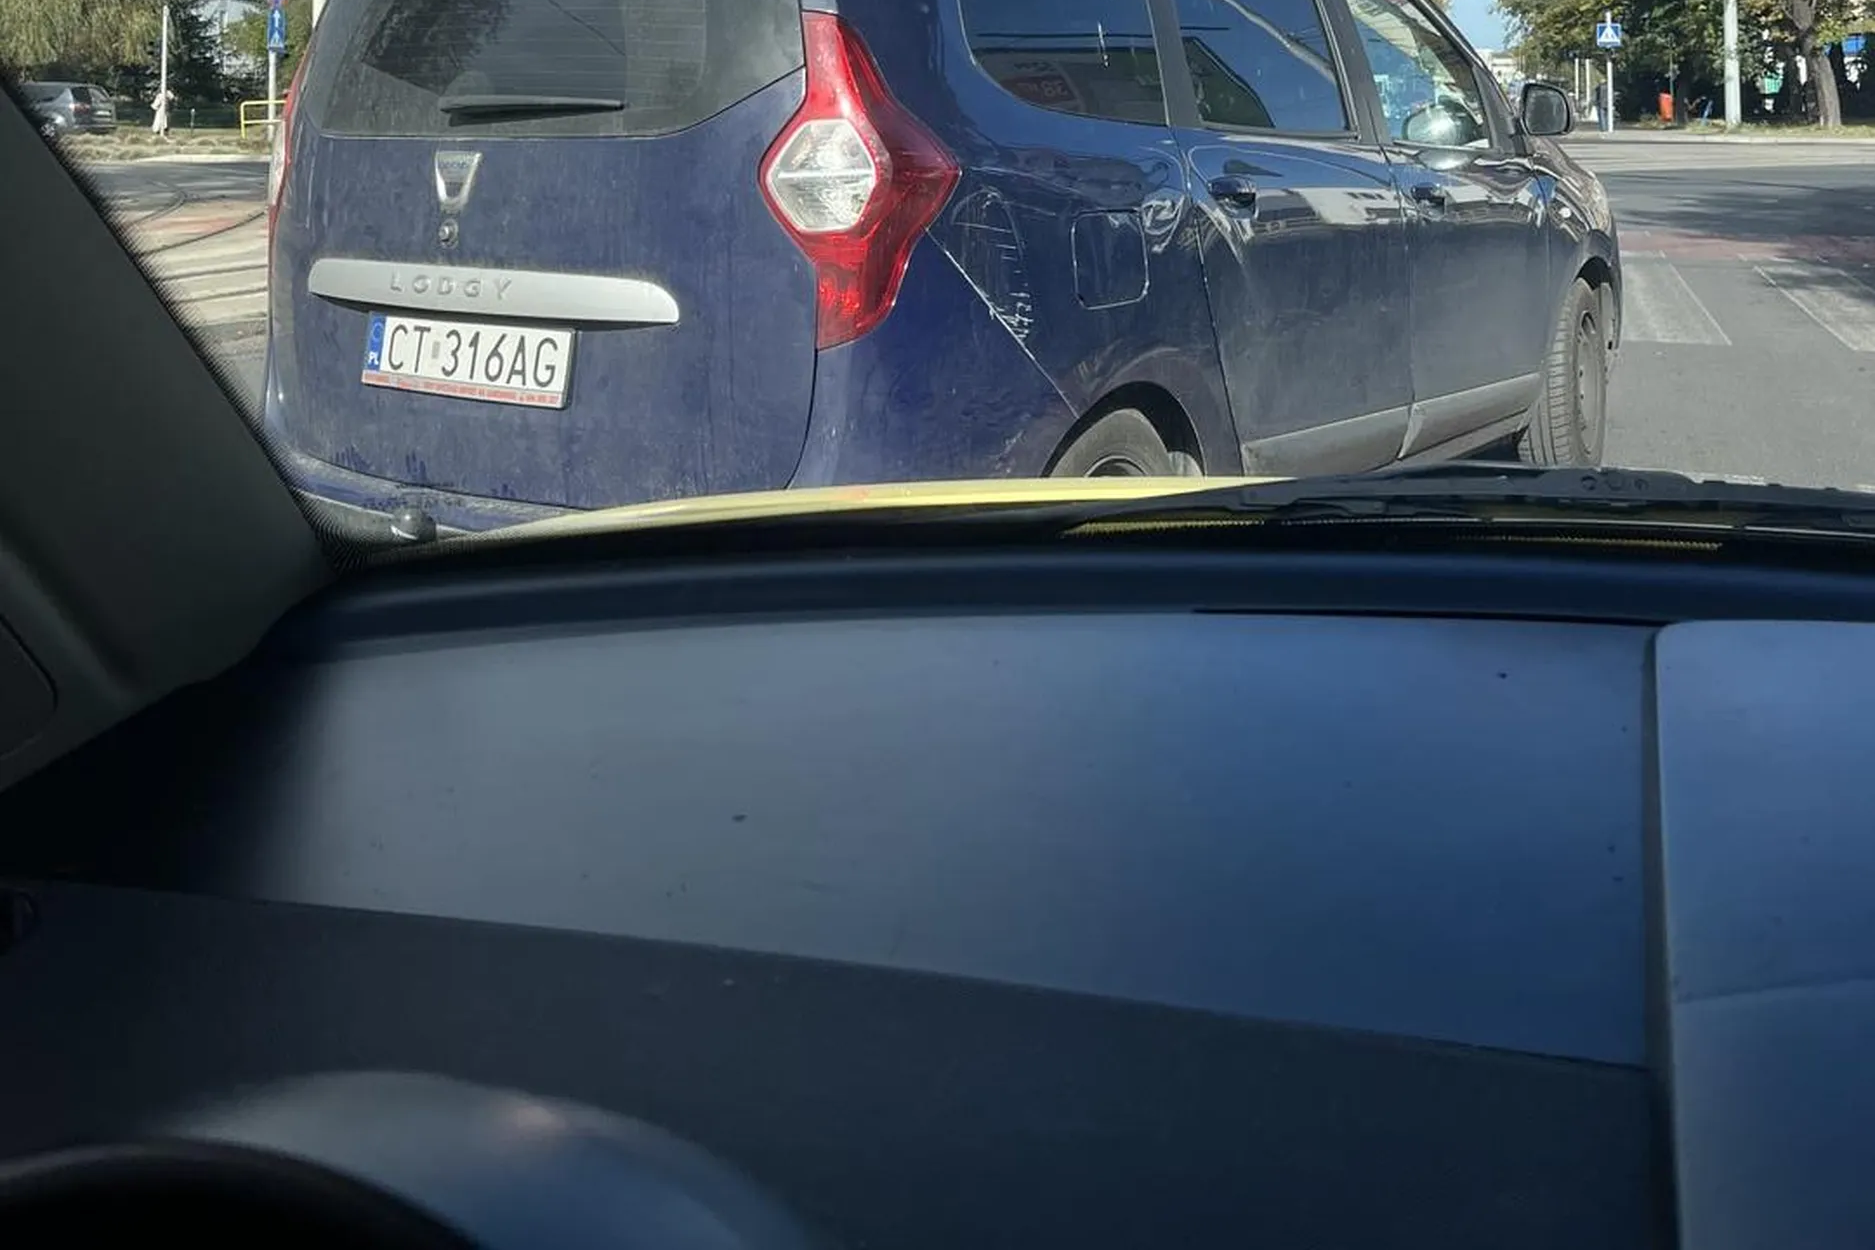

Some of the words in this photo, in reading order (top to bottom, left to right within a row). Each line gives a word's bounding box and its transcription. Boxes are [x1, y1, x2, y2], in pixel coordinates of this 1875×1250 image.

[389, 270, 513, 300] LODGY
[367, 351, 379, 365] PL
[387, 323, 432, 374] CT
[440, 328, 559, 388] 316AG
